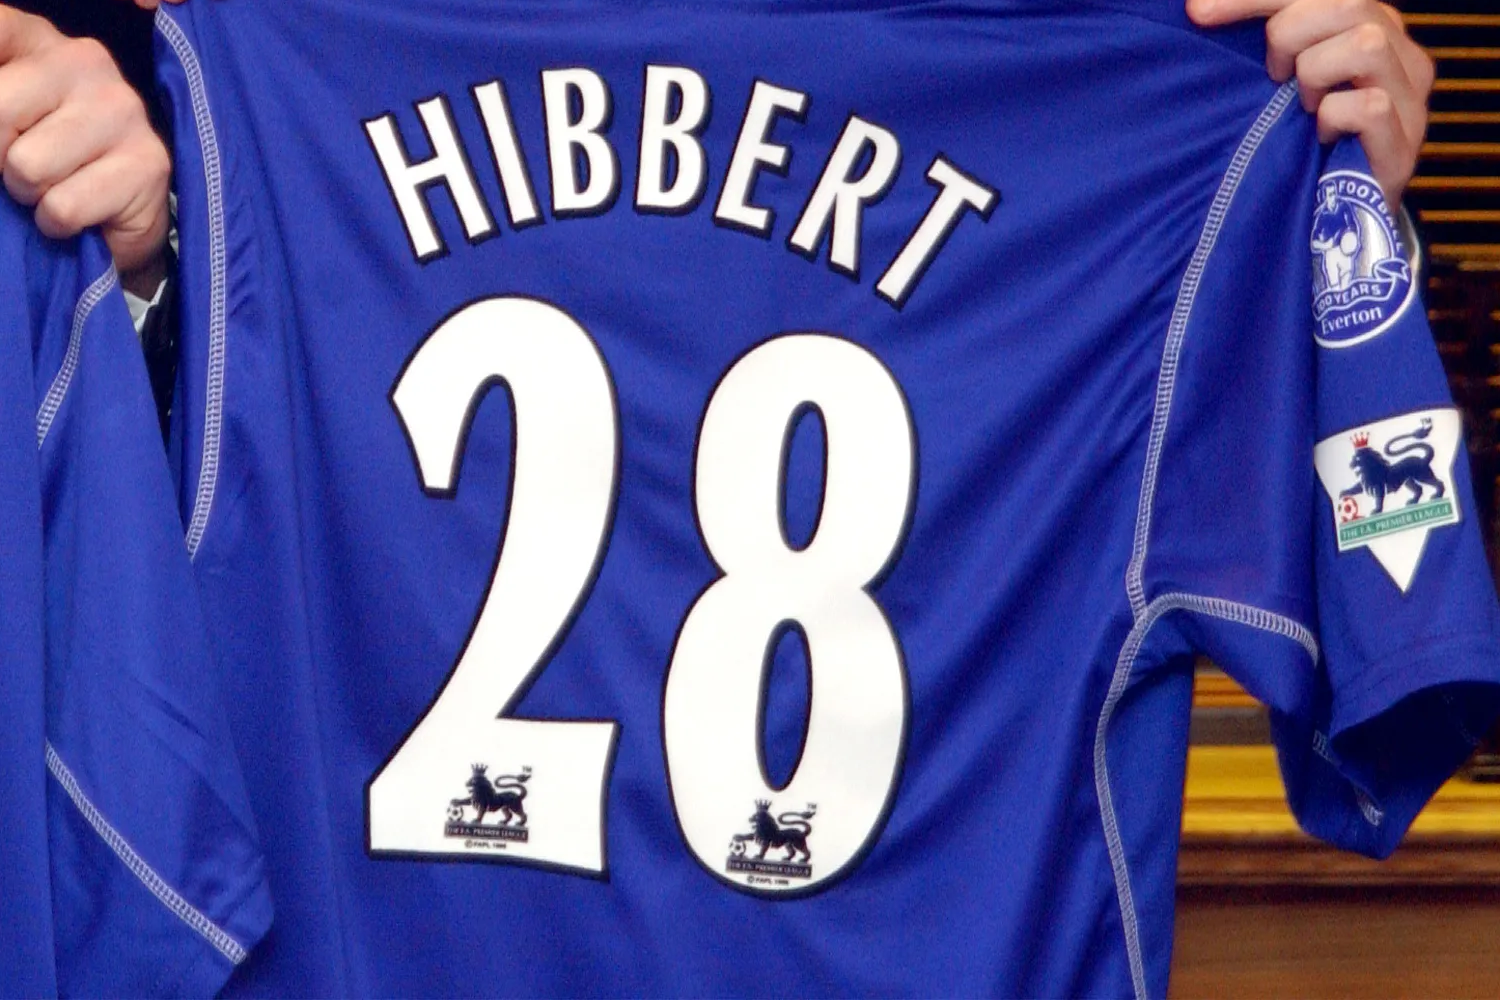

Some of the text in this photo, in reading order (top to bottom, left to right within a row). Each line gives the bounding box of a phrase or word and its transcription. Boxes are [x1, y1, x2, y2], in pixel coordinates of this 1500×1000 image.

[363, 62, 998, 307] HIBBERT
[1333, 283, 1381, 305] YEARS
[1321, 306, 1383, 335] Everton
[1375, 514, 1413, 533] PREMIER
[364, 292, 921, 898] 28
